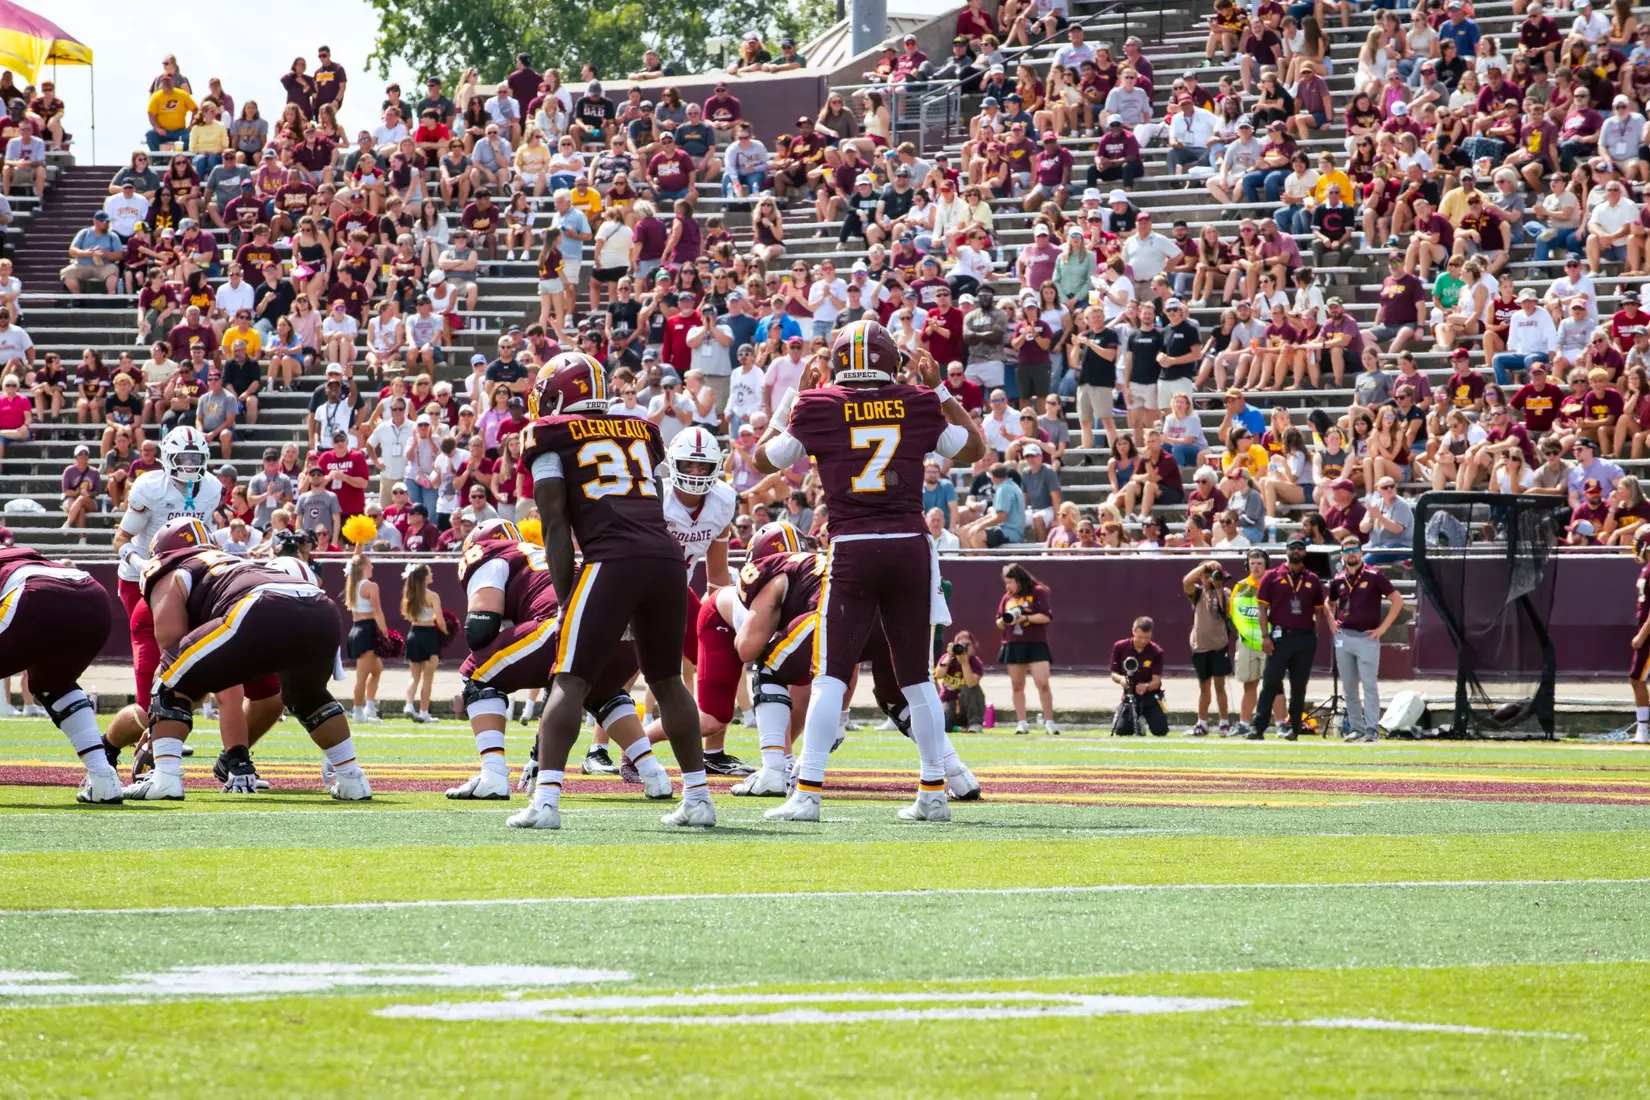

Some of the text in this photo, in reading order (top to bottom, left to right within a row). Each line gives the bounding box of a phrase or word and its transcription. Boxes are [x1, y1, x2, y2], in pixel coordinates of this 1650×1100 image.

[1322, 213, 1343, 231] C
[843, 371, 878, 379] RESPECT
[586, 401, 608, 409] TRUTH
[844, 399, 905, 422] FLORES
[568, 418, 651, 441] CLERVEAUX
[850, 424, 902, 492] 7
[577, 438, 659, 500] 31
[671, 529, 712, 543] COLGATE
